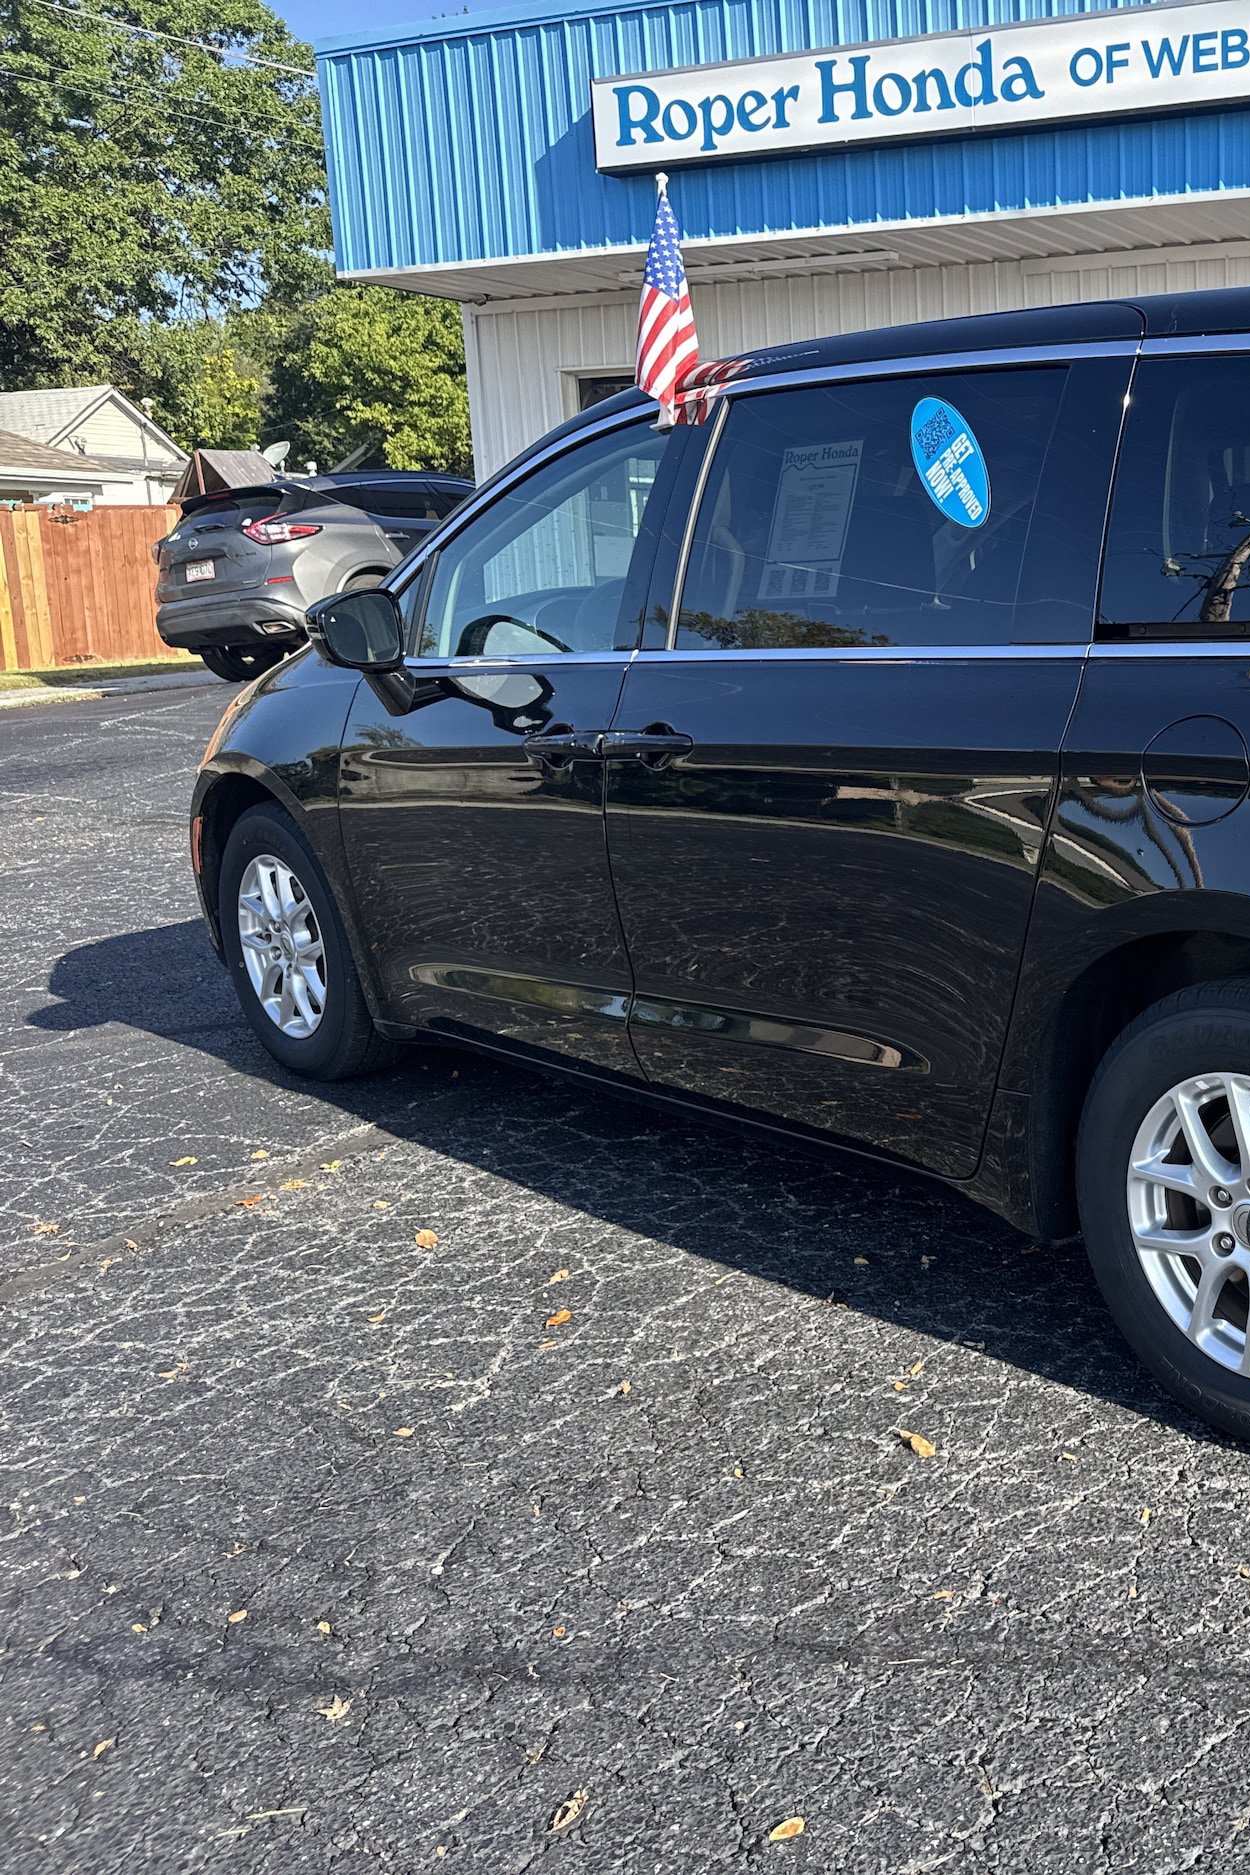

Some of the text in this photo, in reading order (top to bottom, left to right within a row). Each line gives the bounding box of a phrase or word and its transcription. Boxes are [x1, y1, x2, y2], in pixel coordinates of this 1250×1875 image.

[612, 85, 800, 150] Roper
[814, 40, 1045, 124] Honda
[1069, 43, 1131, 87] OF
[785, 445, 859, 466] Roper Honda
[950, 432, 975, 464] GET
